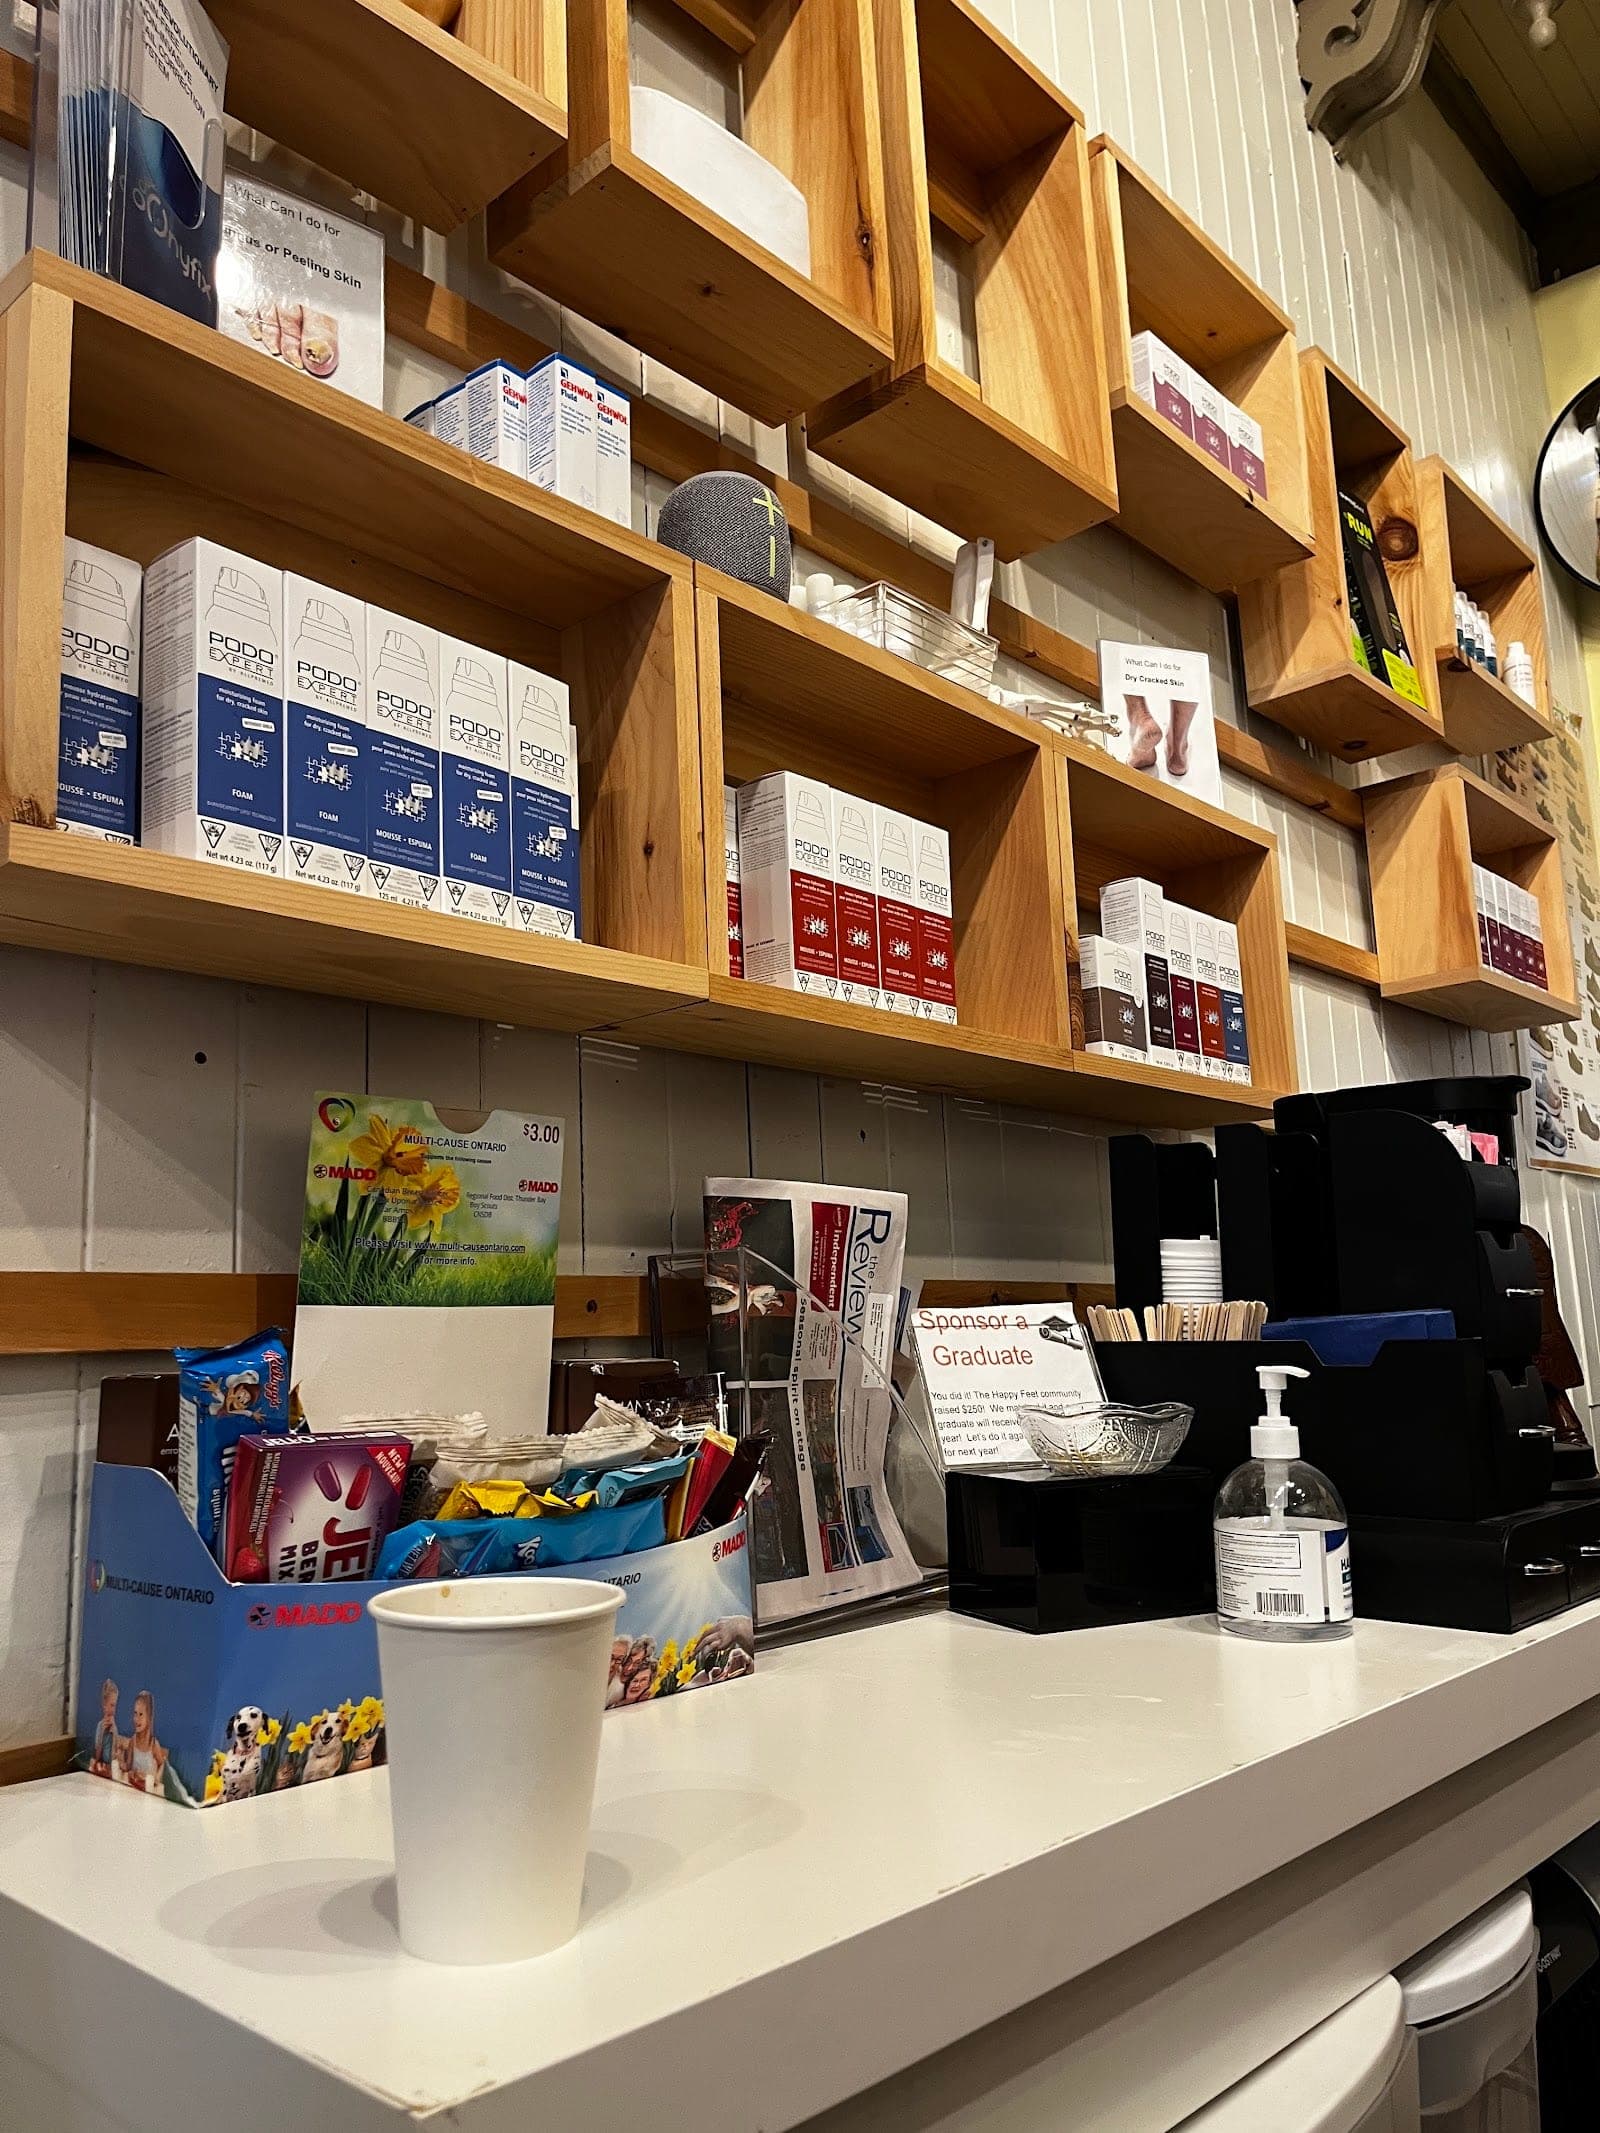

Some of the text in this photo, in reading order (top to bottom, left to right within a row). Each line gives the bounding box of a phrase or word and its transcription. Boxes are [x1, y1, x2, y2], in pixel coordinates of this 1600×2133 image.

[271, 201, 295, 218] Can
[306, 216, 321, 229] do
[325, 222, 341, 237] for
[265, 243, 362, 289] or Peeling Skin
[561, 379, 593, 402] GEHWOL
[597, 403, 628, 425] GEHWOL
[61, 627, 129, 661] PODO
[209, 631, 273, 664] PODO
[209, 647, 273, 680] EXPERT
[1126, 658, 1143, 667] What
[1144, 660, 1158, 668] Can
[298, 661, 356, 691] PODO
[1125, 674, 1184, 687] Dry Cracked Skin
[298, 675, 356, 705] EXPERT
[377, 690, 431, 719] PODO
[377, 704, 432, 733] EXPERT
[450, 715, 500, 741] PODO
[520, 740, 565, 766] PODO
[60, 782, 124, 806] OUSSE ESPUMA
[232, 788, 253, 800] FOAM
[319, 811, 339, 822] FOAM
[376, 829, 432, 850] MOUSSE ESPUMA
[795, 839, 828, 858] PODO
[840, 853, 871, 872] PODO
[882, 867, 911, 885] PODO
[920, 880, 947, 896] PODO
[404, 1135, 507, 1152] MULTI-CAUSE ONTARIO
[523, 1123, 560, 1143] $3.00
[329, 1166, 377, 1181] MADD
[528, 1181, 558, 1193] MADD
[355, 1238, 389, 1249] Please
[414, 1241, 526, 1253] www.multi-causeontario.com
[436, 1257, 458, 1265] more
[460, 1257, 478, 1266] info.
[828, 1229, 843, 1308] Independent
[847, 1208, 892, 1334] Review
[868, 1256, 879, 1279] the
[919, 1310, 1029, 1336] Sponsor a
[933, 1345, 1034, 1366] Graduate
[261, 1350, 286, 1409] Kellogg's
[791, 1365, 800, 1402] spirit
[931, 1391, 947, 1400] You
[949, 1391, 962, 1399] did
[973, 1390, 990, 1399] The
[993, 1390, 1018, 1400] Happy
[1020, 1389, 1039, 1398] Feet
[1040, 1390, 1082, 1399] community
[793, 1408, 800, 1426] on
[934, 1404, 960, 1414] raised
[990, 1404, 1004, 1413] We
[938, 1419, 990, 1430] graduate will
[941, 1434, 962, 1444] year!
[967, 1432, 987, 1441] Let's
[989, 1432, 1000, 1440] do
[1001, 1431, 1007, 1440] it
[387, 1448, 406, 1472] NEW!
[796, 1431, 807, 1471] stage
[944, 1447, 999, 1456] for next year!
[375, 1451, 401, 1486] NOUVEAU!
[278, 1545, 298, 1580] MIX
[107, 1576, 214, 1605] MULTI-CAUSE ONTARIO
[275, 1602, 362, 1627] MADD
